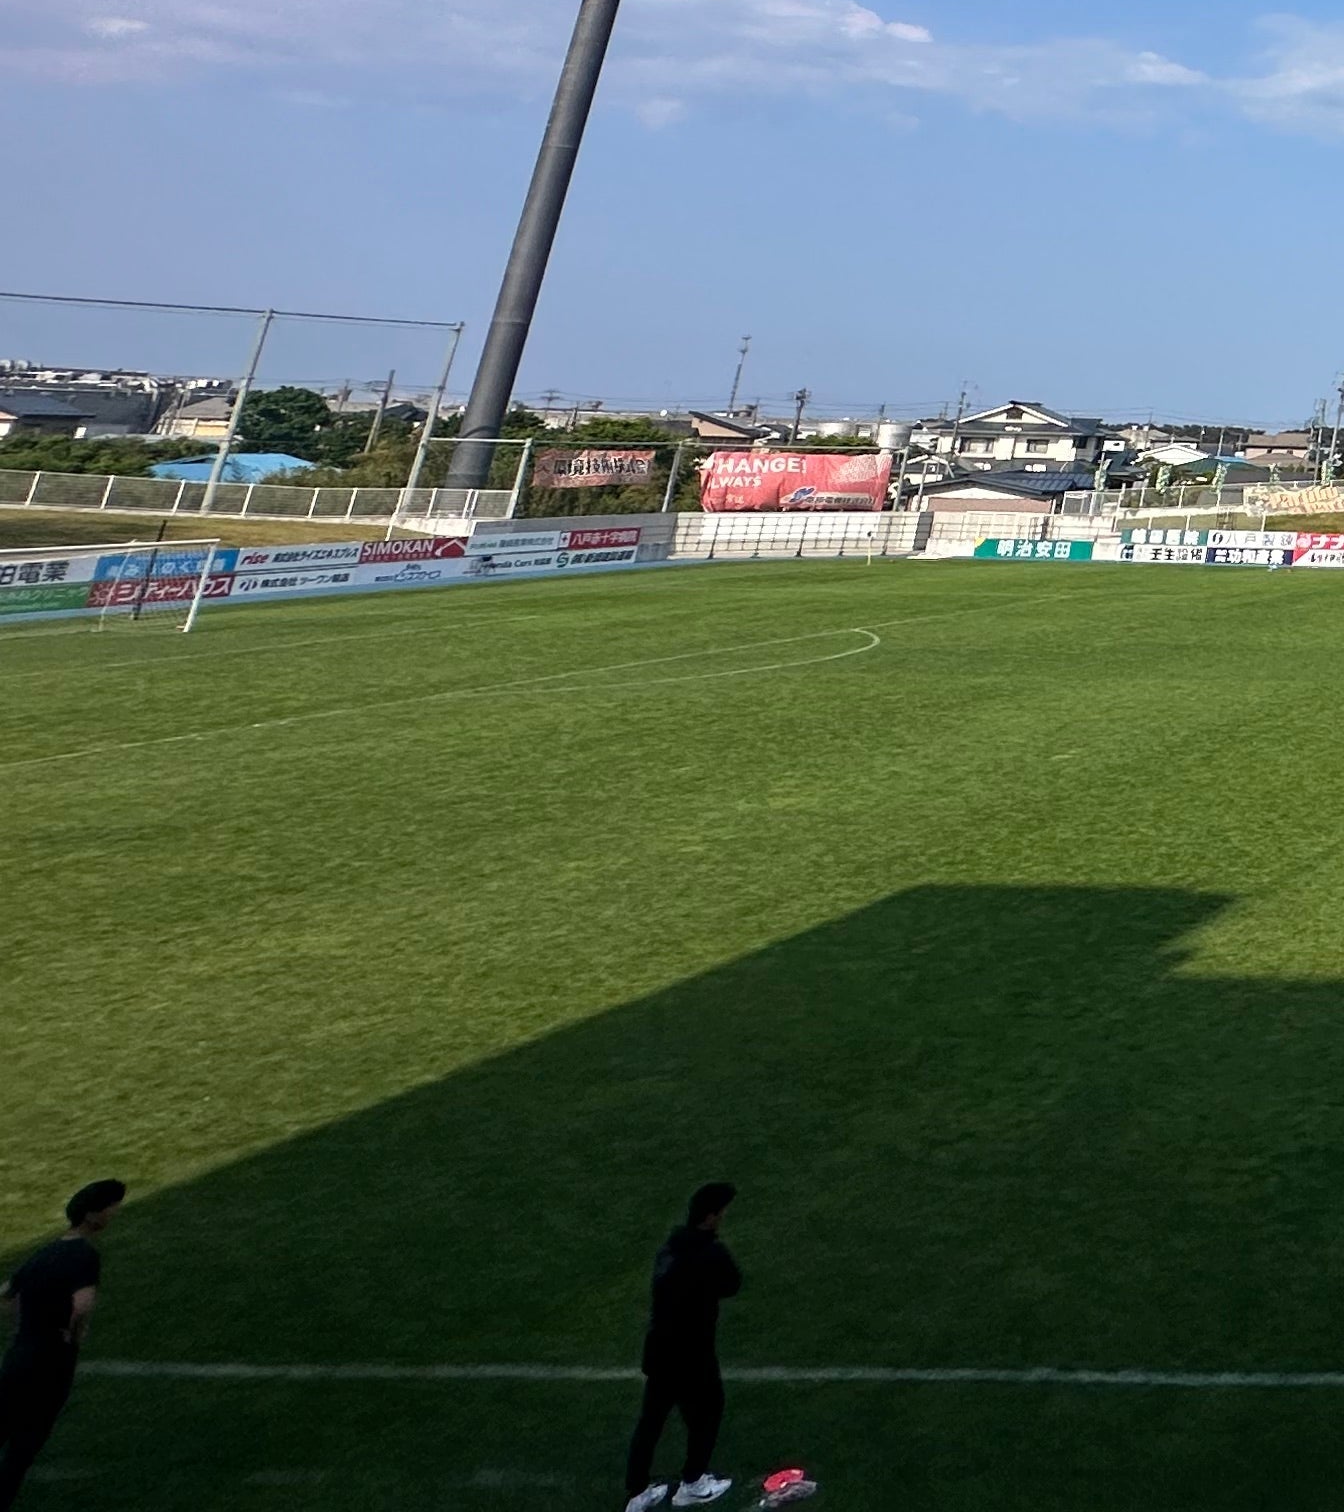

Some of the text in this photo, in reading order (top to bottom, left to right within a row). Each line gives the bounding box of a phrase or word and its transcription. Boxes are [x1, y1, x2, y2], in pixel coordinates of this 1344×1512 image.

[713, 457, 808, 475] HANGE!
[709, 475, 763, 490] LWAYS
[363, 541, 435, 557] SIMOKAN
[995, 540, 1072, 559] 明治安田
[241, 552, 270, 566] rise
